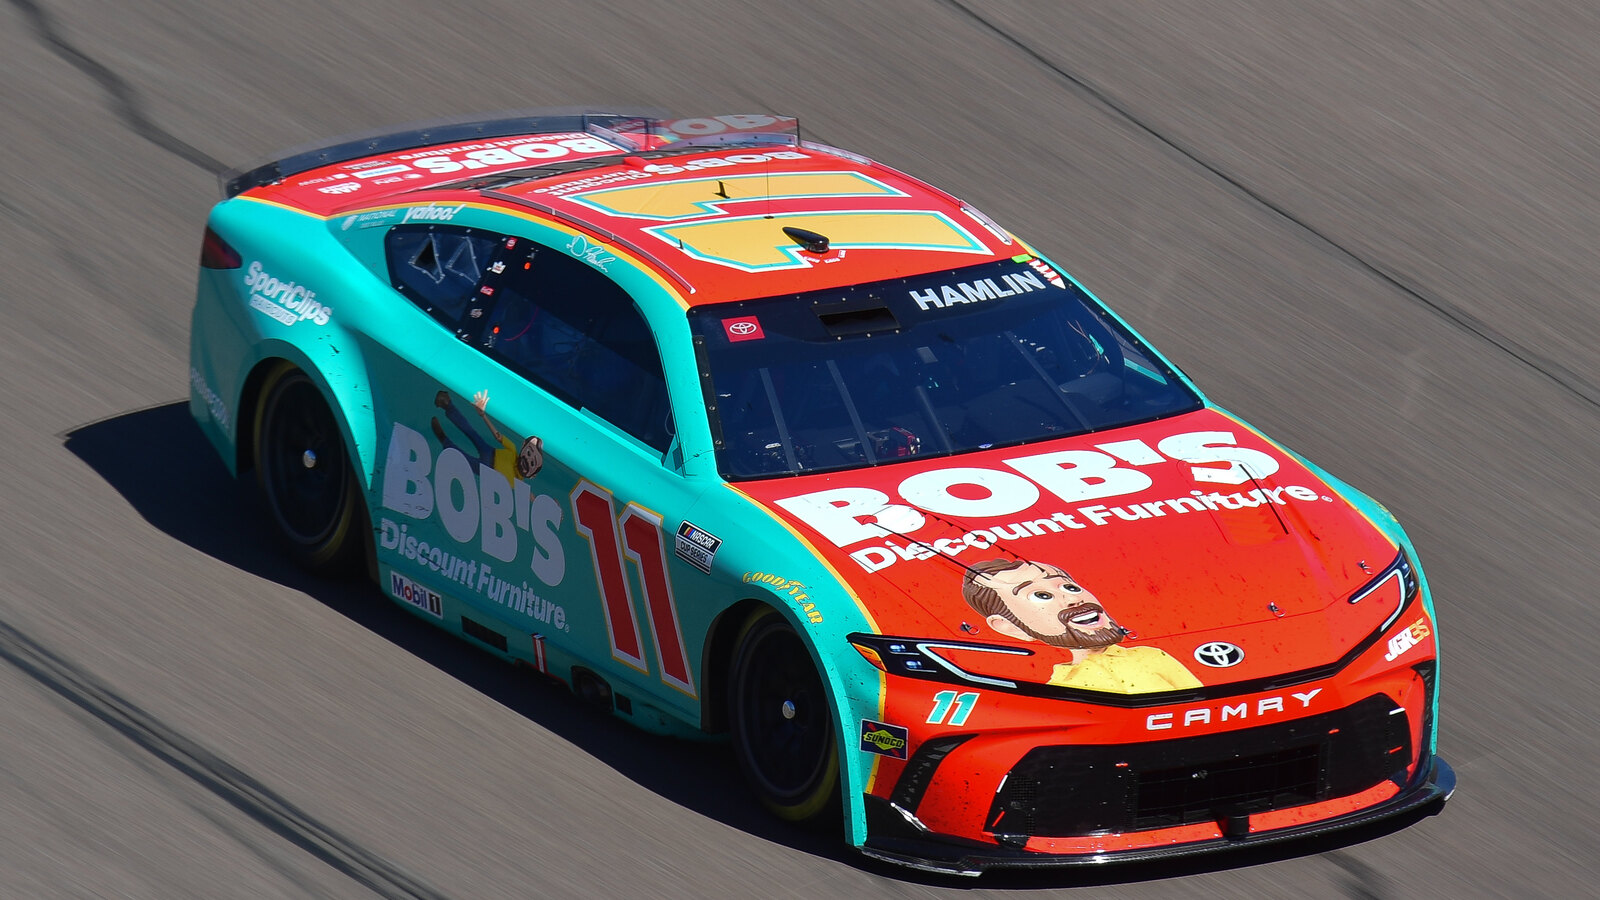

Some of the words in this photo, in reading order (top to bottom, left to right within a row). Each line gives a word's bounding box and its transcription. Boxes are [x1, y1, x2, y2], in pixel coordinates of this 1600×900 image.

[413, 138, 619, 174] BOB'S
[643, 151, 811, 176] BOB'S
[400, 202, 467, 225] yahoo!
[908, 270, 1047, 311] HAMLIN
[382, 421, 566, 587] BOB'S
[773, 431, 1282, 548] BOB'S
[380, 518, 477, 588] Discount
[680, 540, 691, 552] CUP
[690, 545, 709, 564] SERIES
[690, 529, 716, 549] NASCAR
[849, 507, 1087, 574] Discount
[391, 573, 428, 611] Mobil
[569, 477, 699, 701] 11
[742, 571, 824, 625] GOODYEAR
[925, 690, 980, 726] 11
[1146, 688, 1323, 731] CAMRY
[865, 733, 904, 749] SUNOCO
